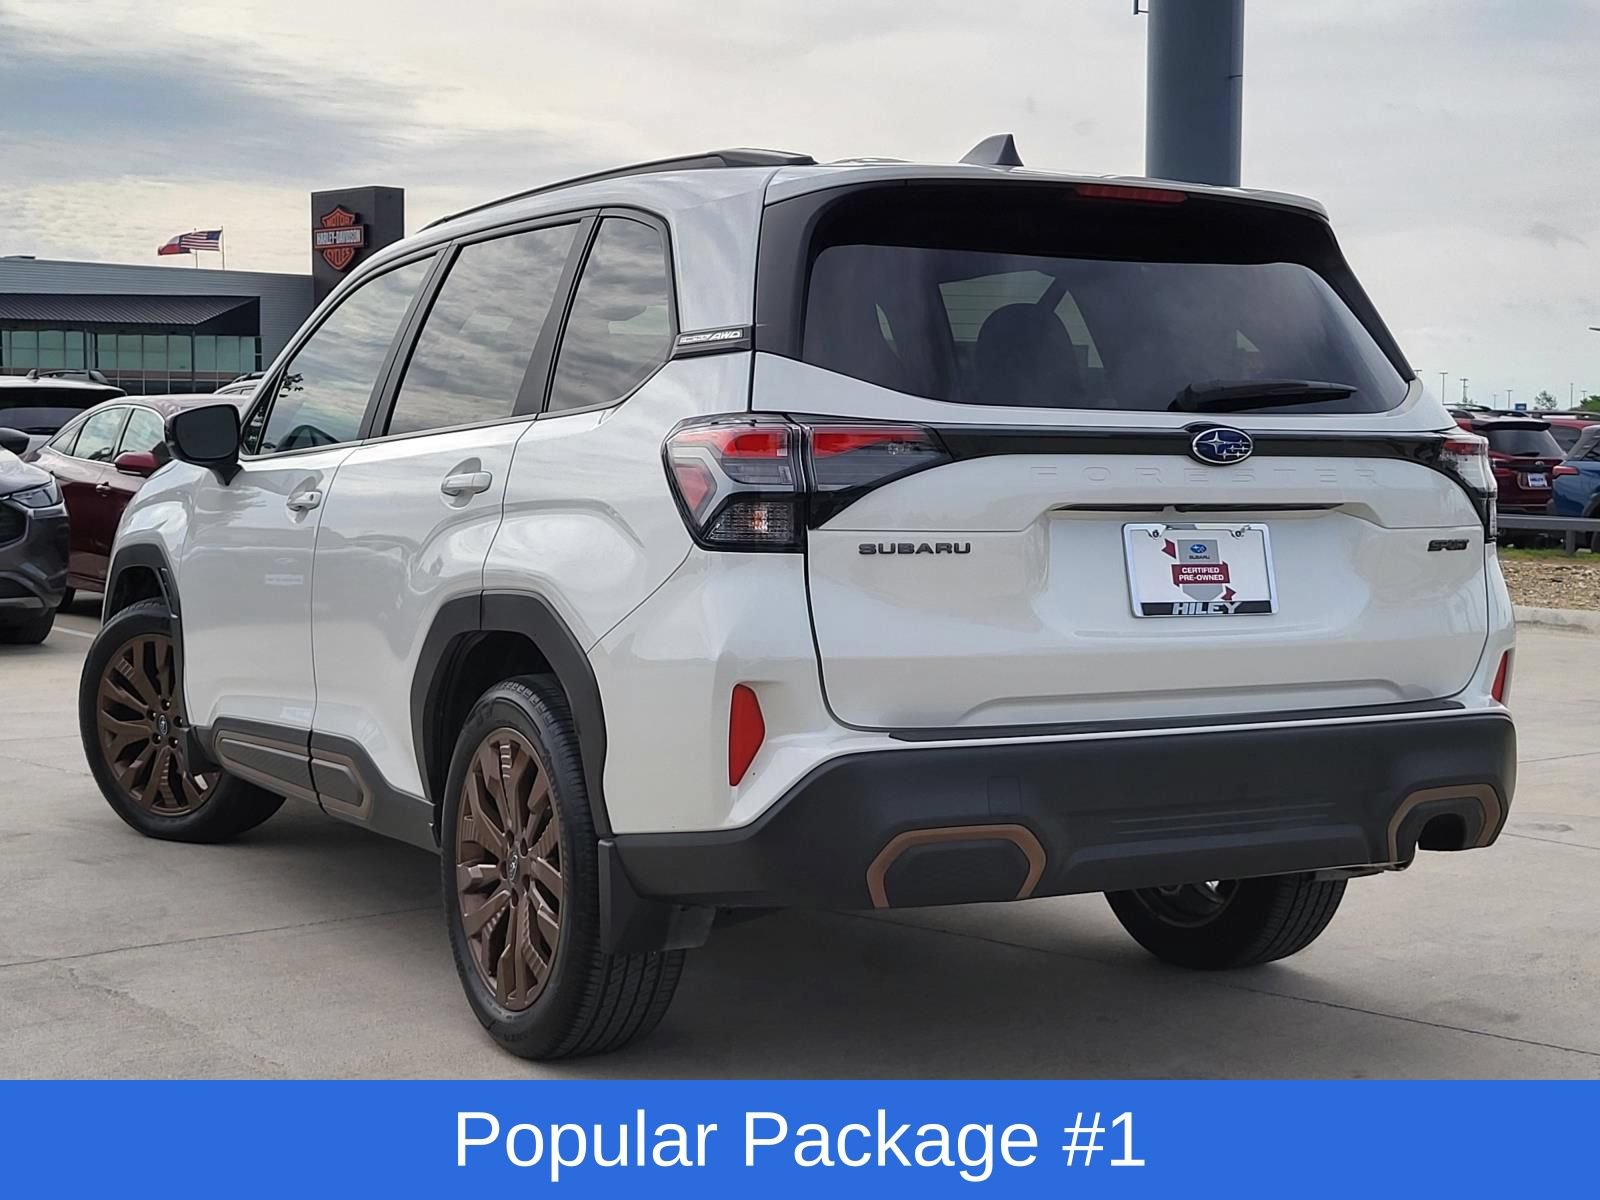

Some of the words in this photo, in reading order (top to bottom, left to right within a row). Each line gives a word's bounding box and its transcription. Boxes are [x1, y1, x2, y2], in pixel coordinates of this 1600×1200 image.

[1030, 465, 1379, 485] FORESTER
[858, 542, 971, 555] SUBARU
[1181, 566, 1220, 574] CERTIFIED
[1172, 601, 1242, 615] HILEY
